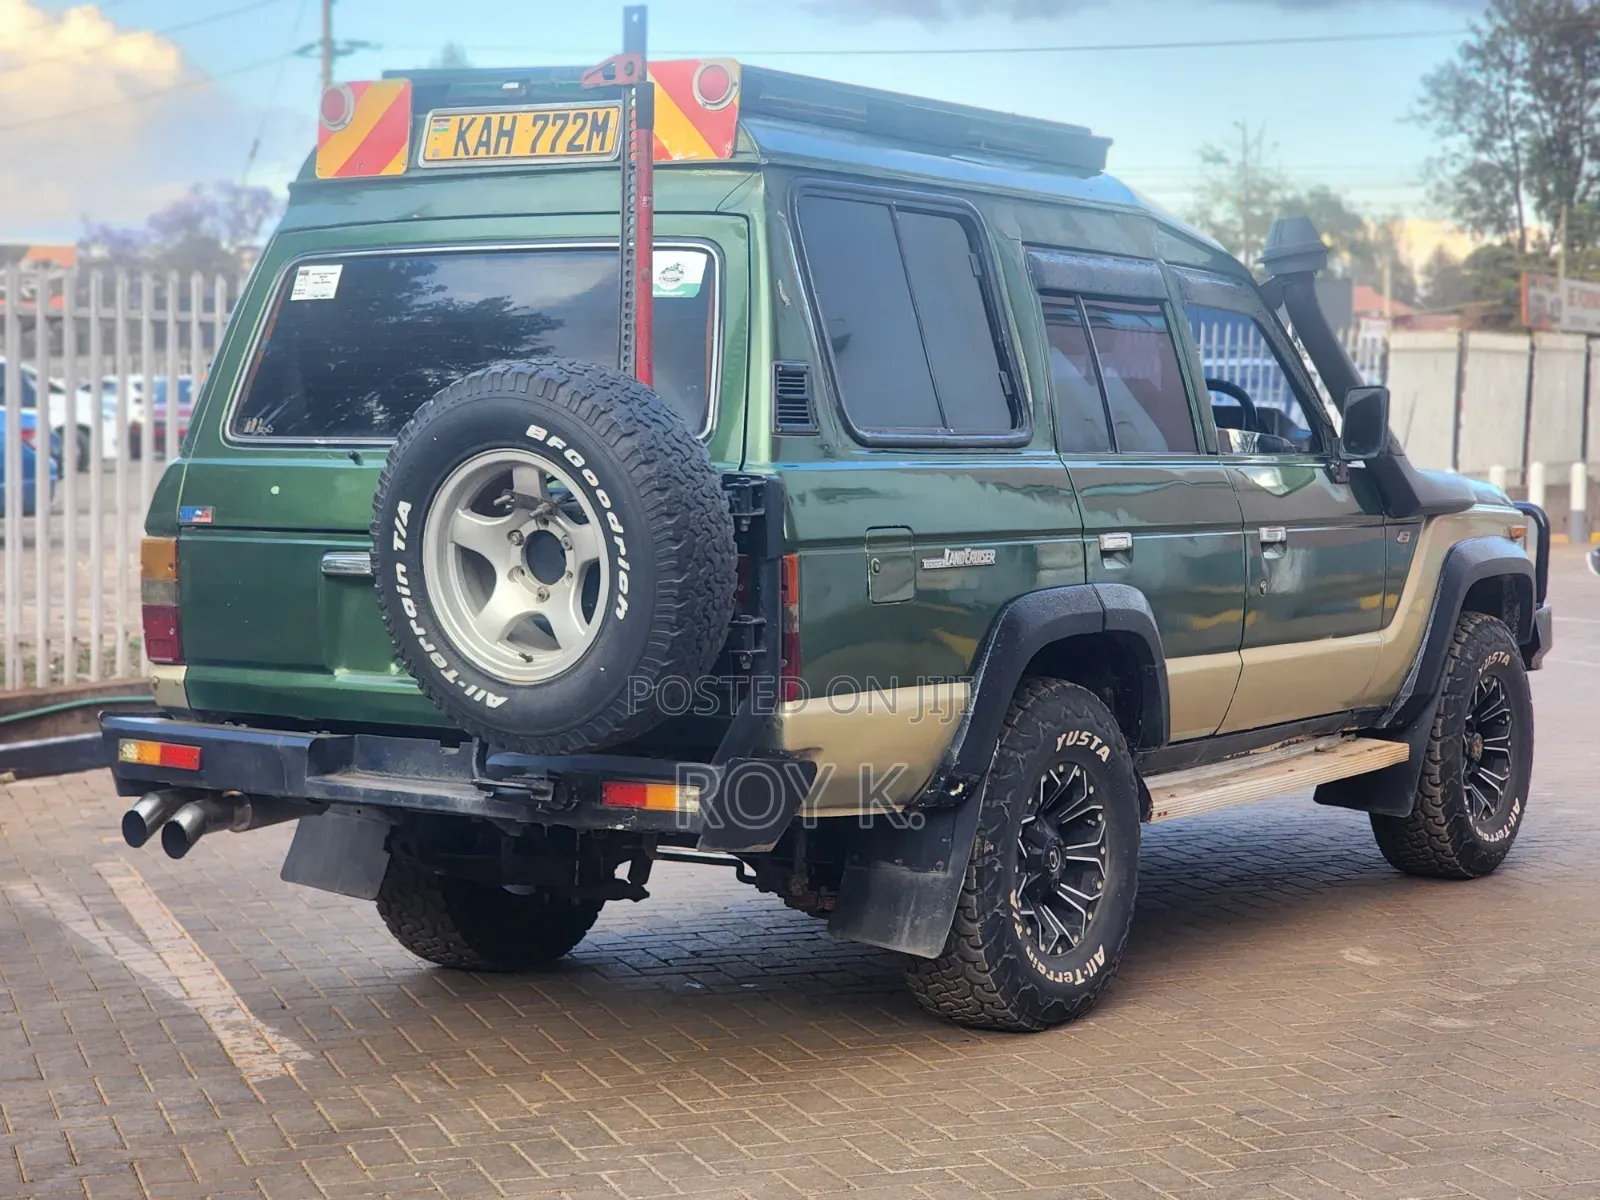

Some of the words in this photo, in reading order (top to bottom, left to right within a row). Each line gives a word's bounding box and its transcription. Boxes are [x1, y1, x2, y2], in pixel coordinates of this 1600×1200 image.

[453, 115, 518, 157] KAH
[529, 111, 611, 154] 772M
[393, 500, 412, 551] T/A
[396, 563, 509, 709] All-Terrain
[1055, 730, 1111, 763] YUSTA
